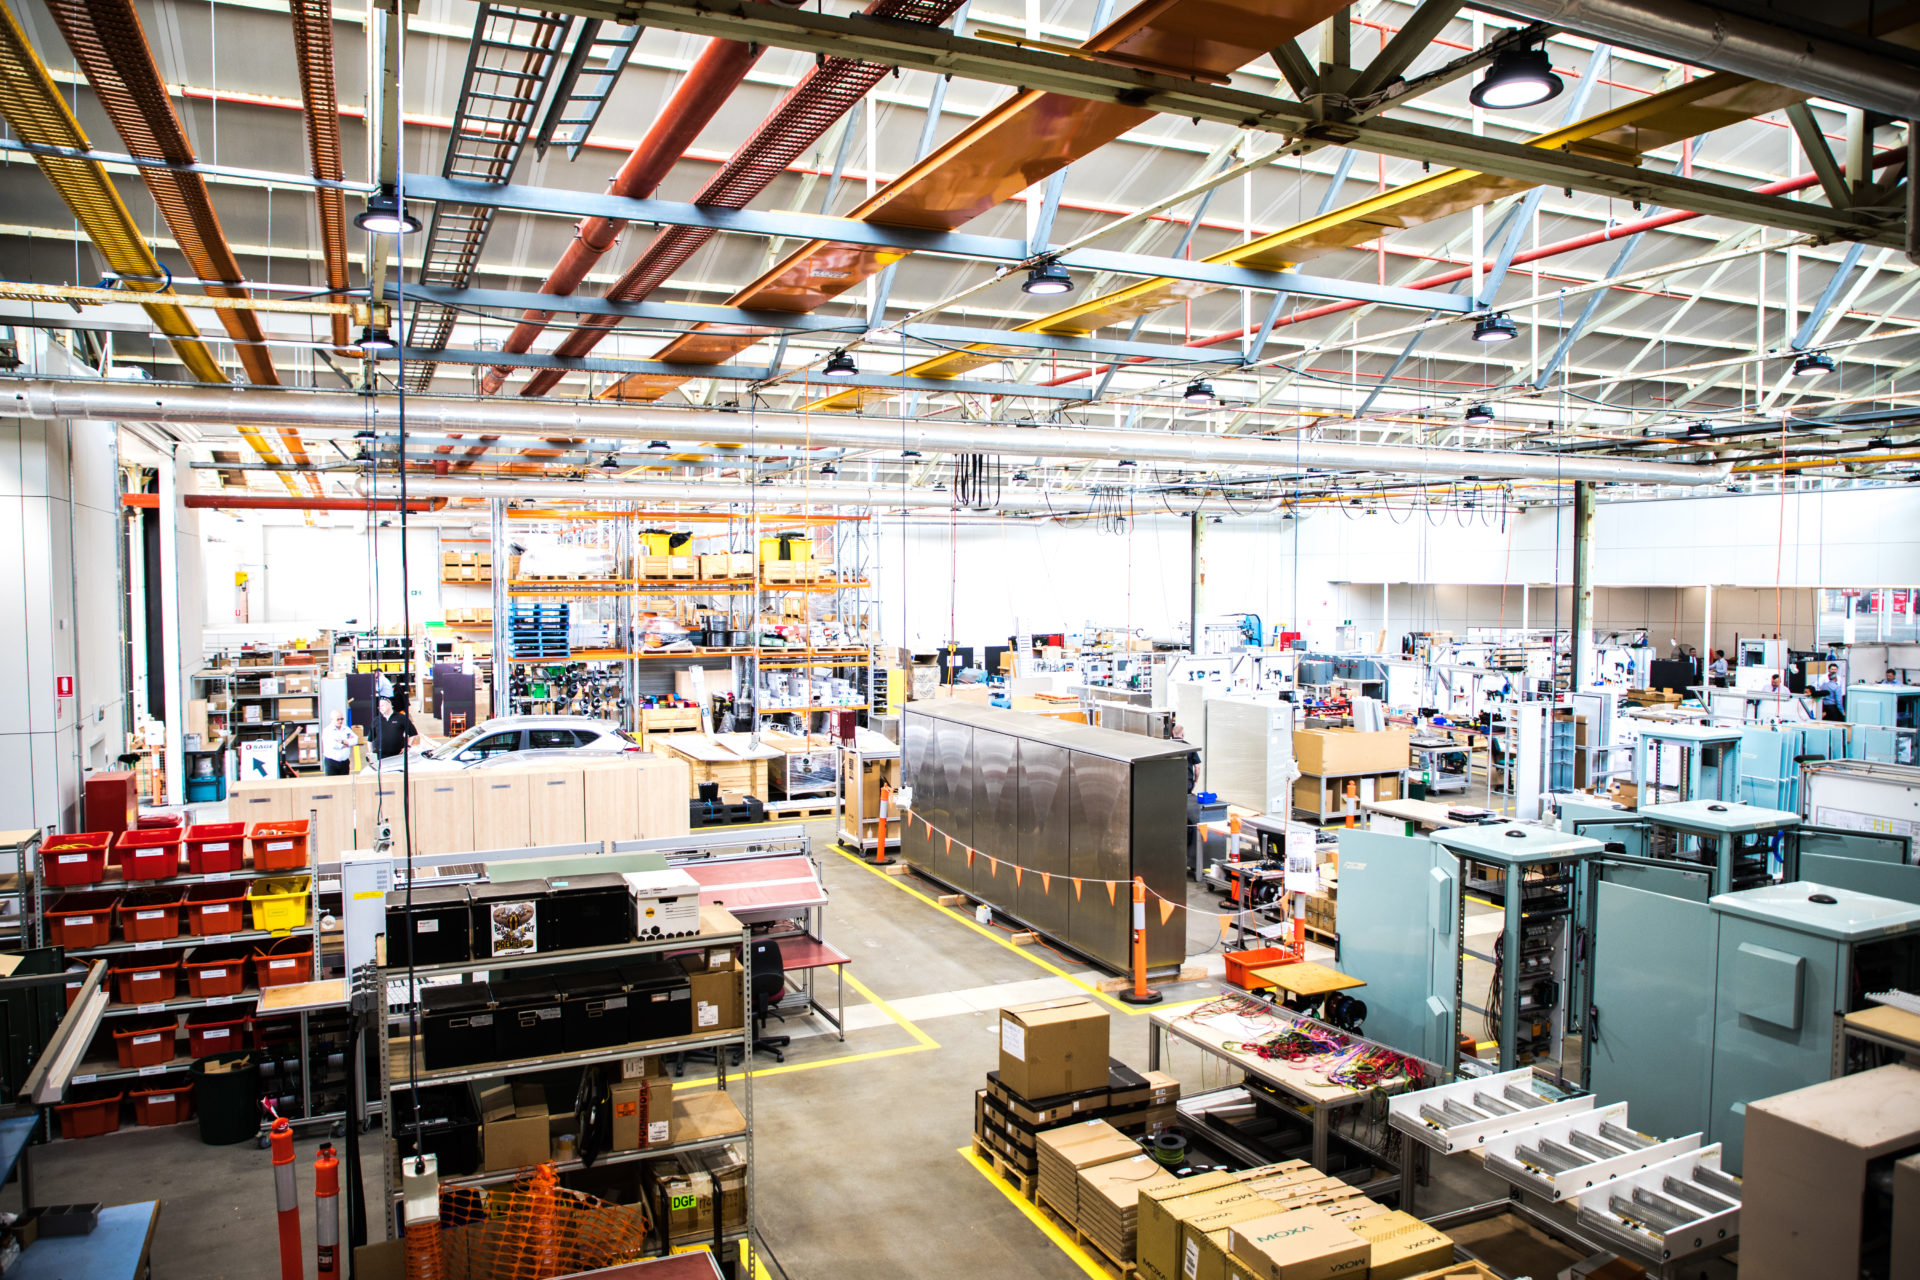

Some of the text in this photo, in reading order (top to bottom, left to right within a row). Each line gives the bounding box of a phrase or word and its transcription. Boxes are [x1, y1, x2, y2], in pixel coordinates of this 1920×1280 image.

[673, 1195, 695, 1209] DGF
[1215, 1193, 1253, 1206] MOXA
[1257, 1225, 1314, 1243] MOXA
[1403, 1236, 1442, 1250] MOXA
[1330, 1258, 1366, 1273] MOXA
